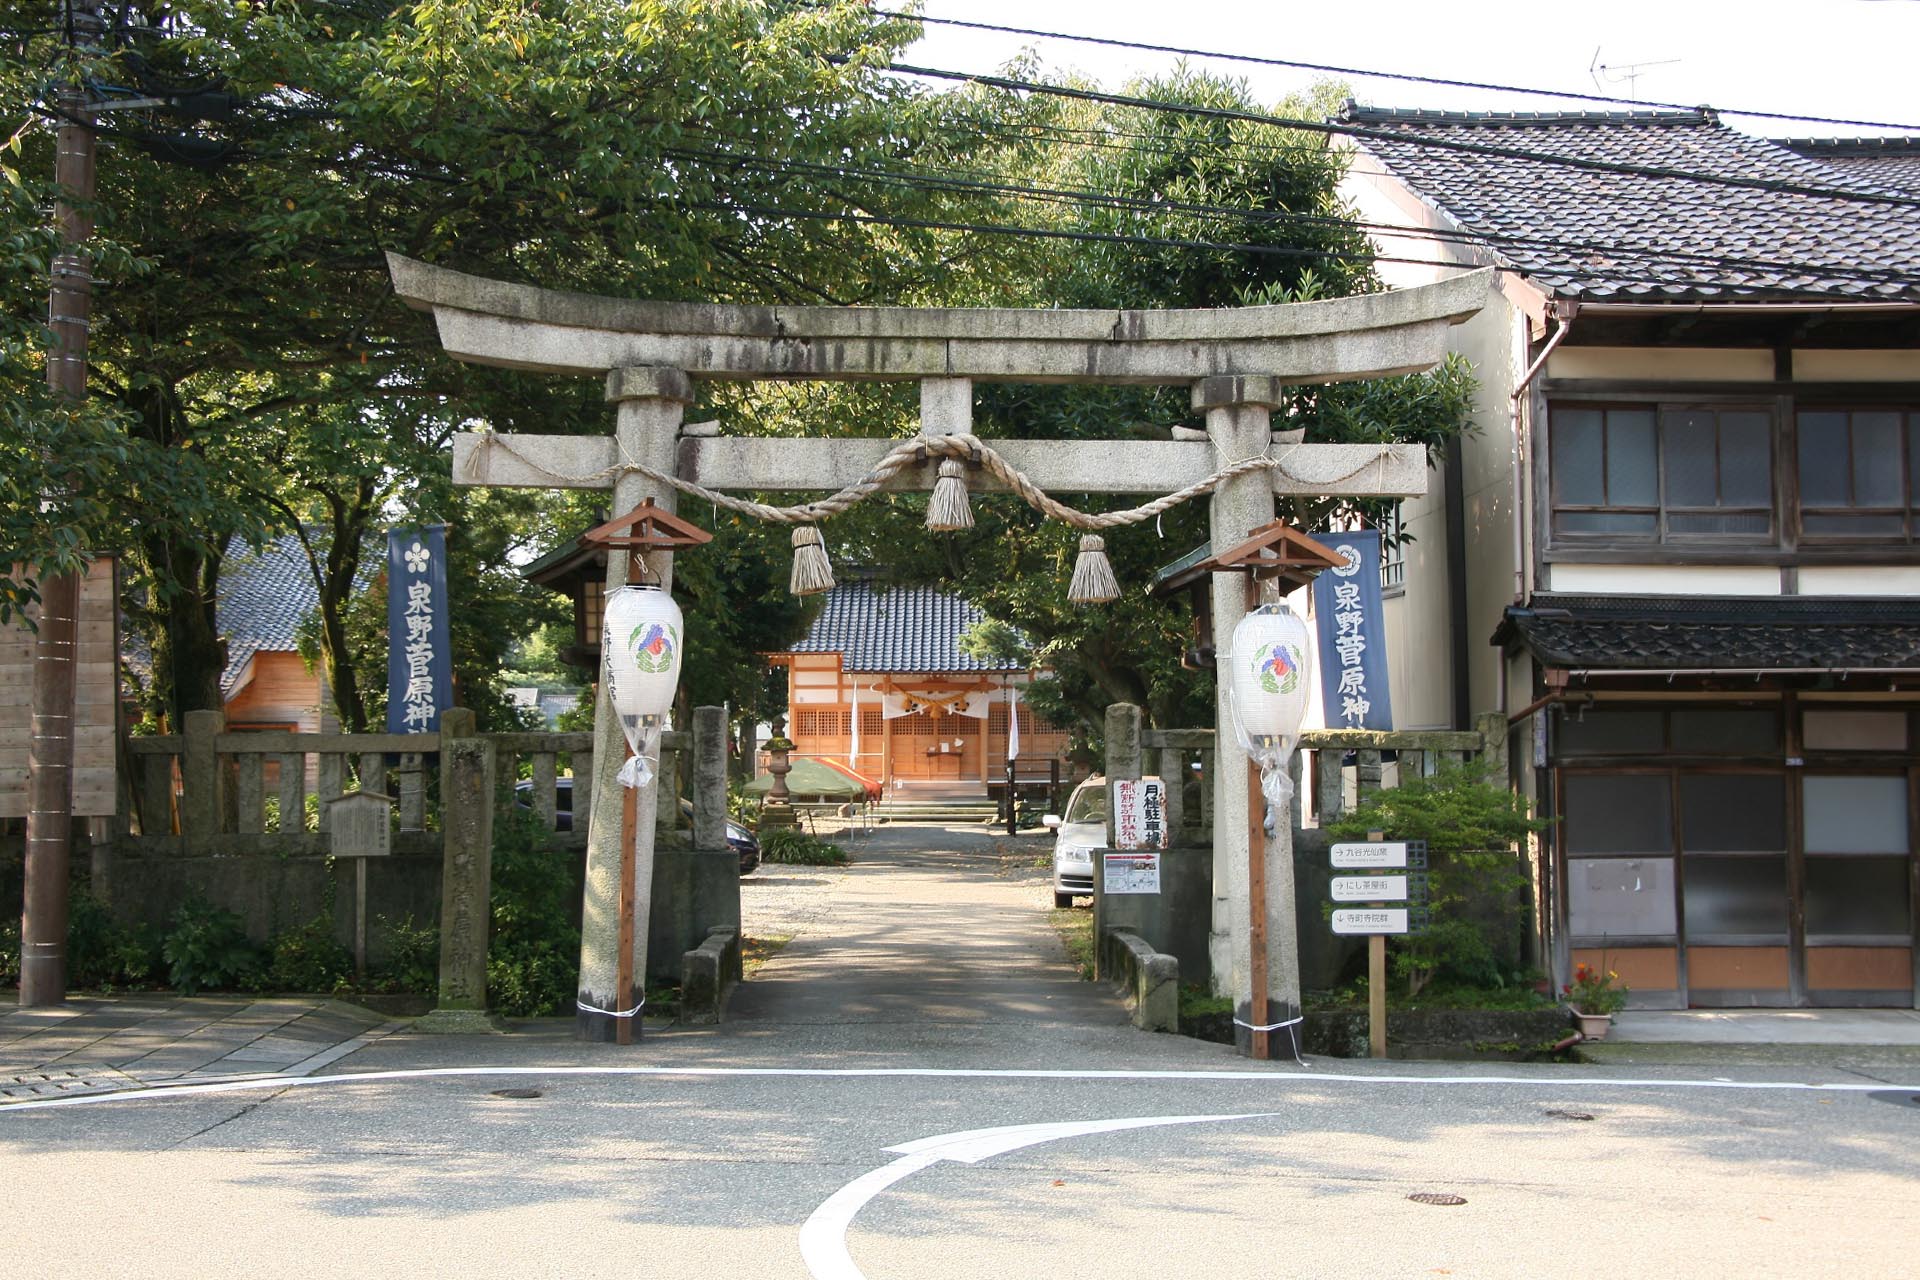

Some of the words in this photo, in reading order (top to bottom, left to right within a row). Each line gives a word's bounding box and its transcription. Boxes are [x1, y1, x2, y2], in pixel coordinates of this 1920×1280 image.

[403, 580, 435, 734] 泉野菅原神
[1334, 580, 1370, 730] 泉野菅原神
[1143, 784, 1161, 845] 月極駐車場
[1346, 880, 1388, 890] にし茶屋街
[1346, 913, 1389, 923] 寺町寺院群
